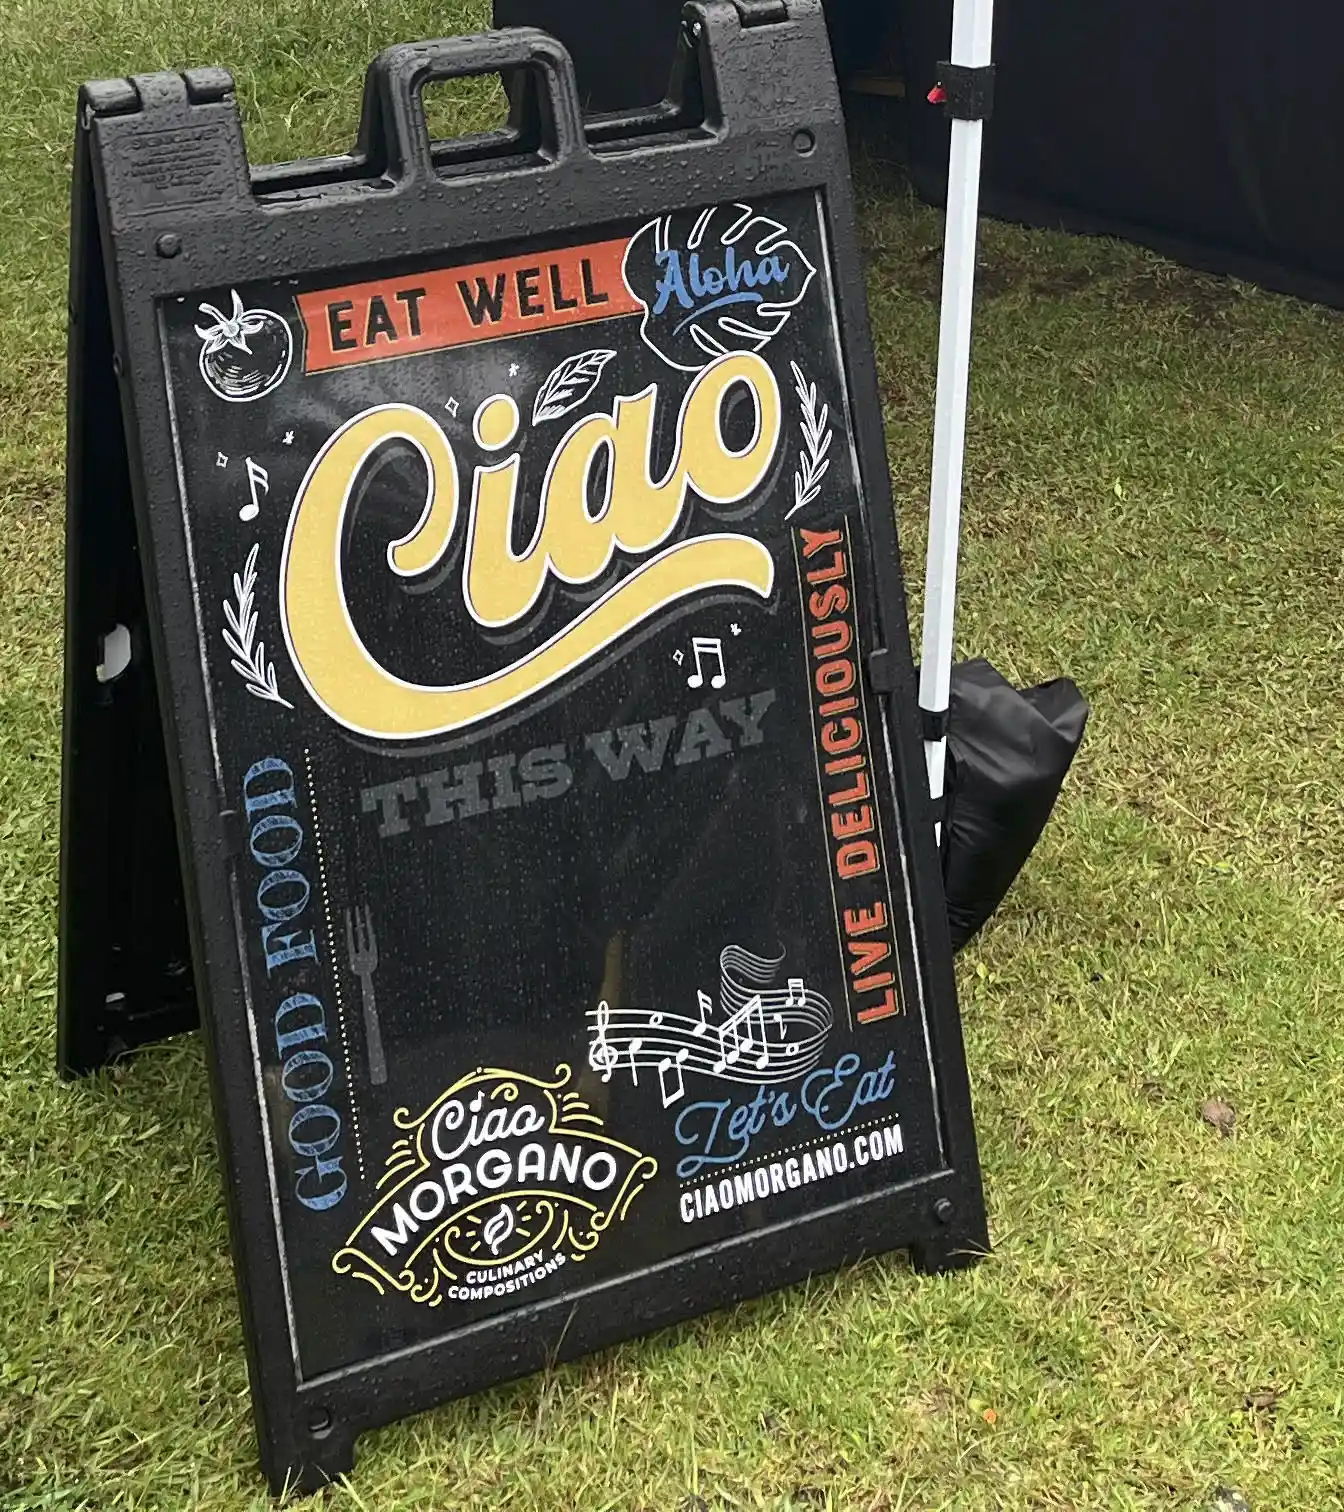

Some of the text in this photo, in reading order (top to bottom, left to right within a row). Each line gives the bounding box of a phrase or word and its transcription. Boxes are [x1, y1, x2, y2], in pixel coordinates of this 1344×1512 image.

[327, 257, 609, 352] EAT WELL
[653, 246, 790, 318] Aloha
[279, 350, 781, 740] Ciao
[362, 690, 777, 839] THIS WAY
[800, 526, 900, 1026] LIVE DELICIOUSLY
[243, 756, 348, 1211] GOOD FOOD
[431, 1089, 545, 1161] Ciao
[675, 1050, 897, 1178] Let's Eat
[370, 1142, 617, 1257] MORGANO
[679, 1124, 904, 1223] CIAOMORGANO.COM
[447, 1253, 566, 1300] COMPOSITIONS
[465, 1248, 544, 1285] CULINARY
